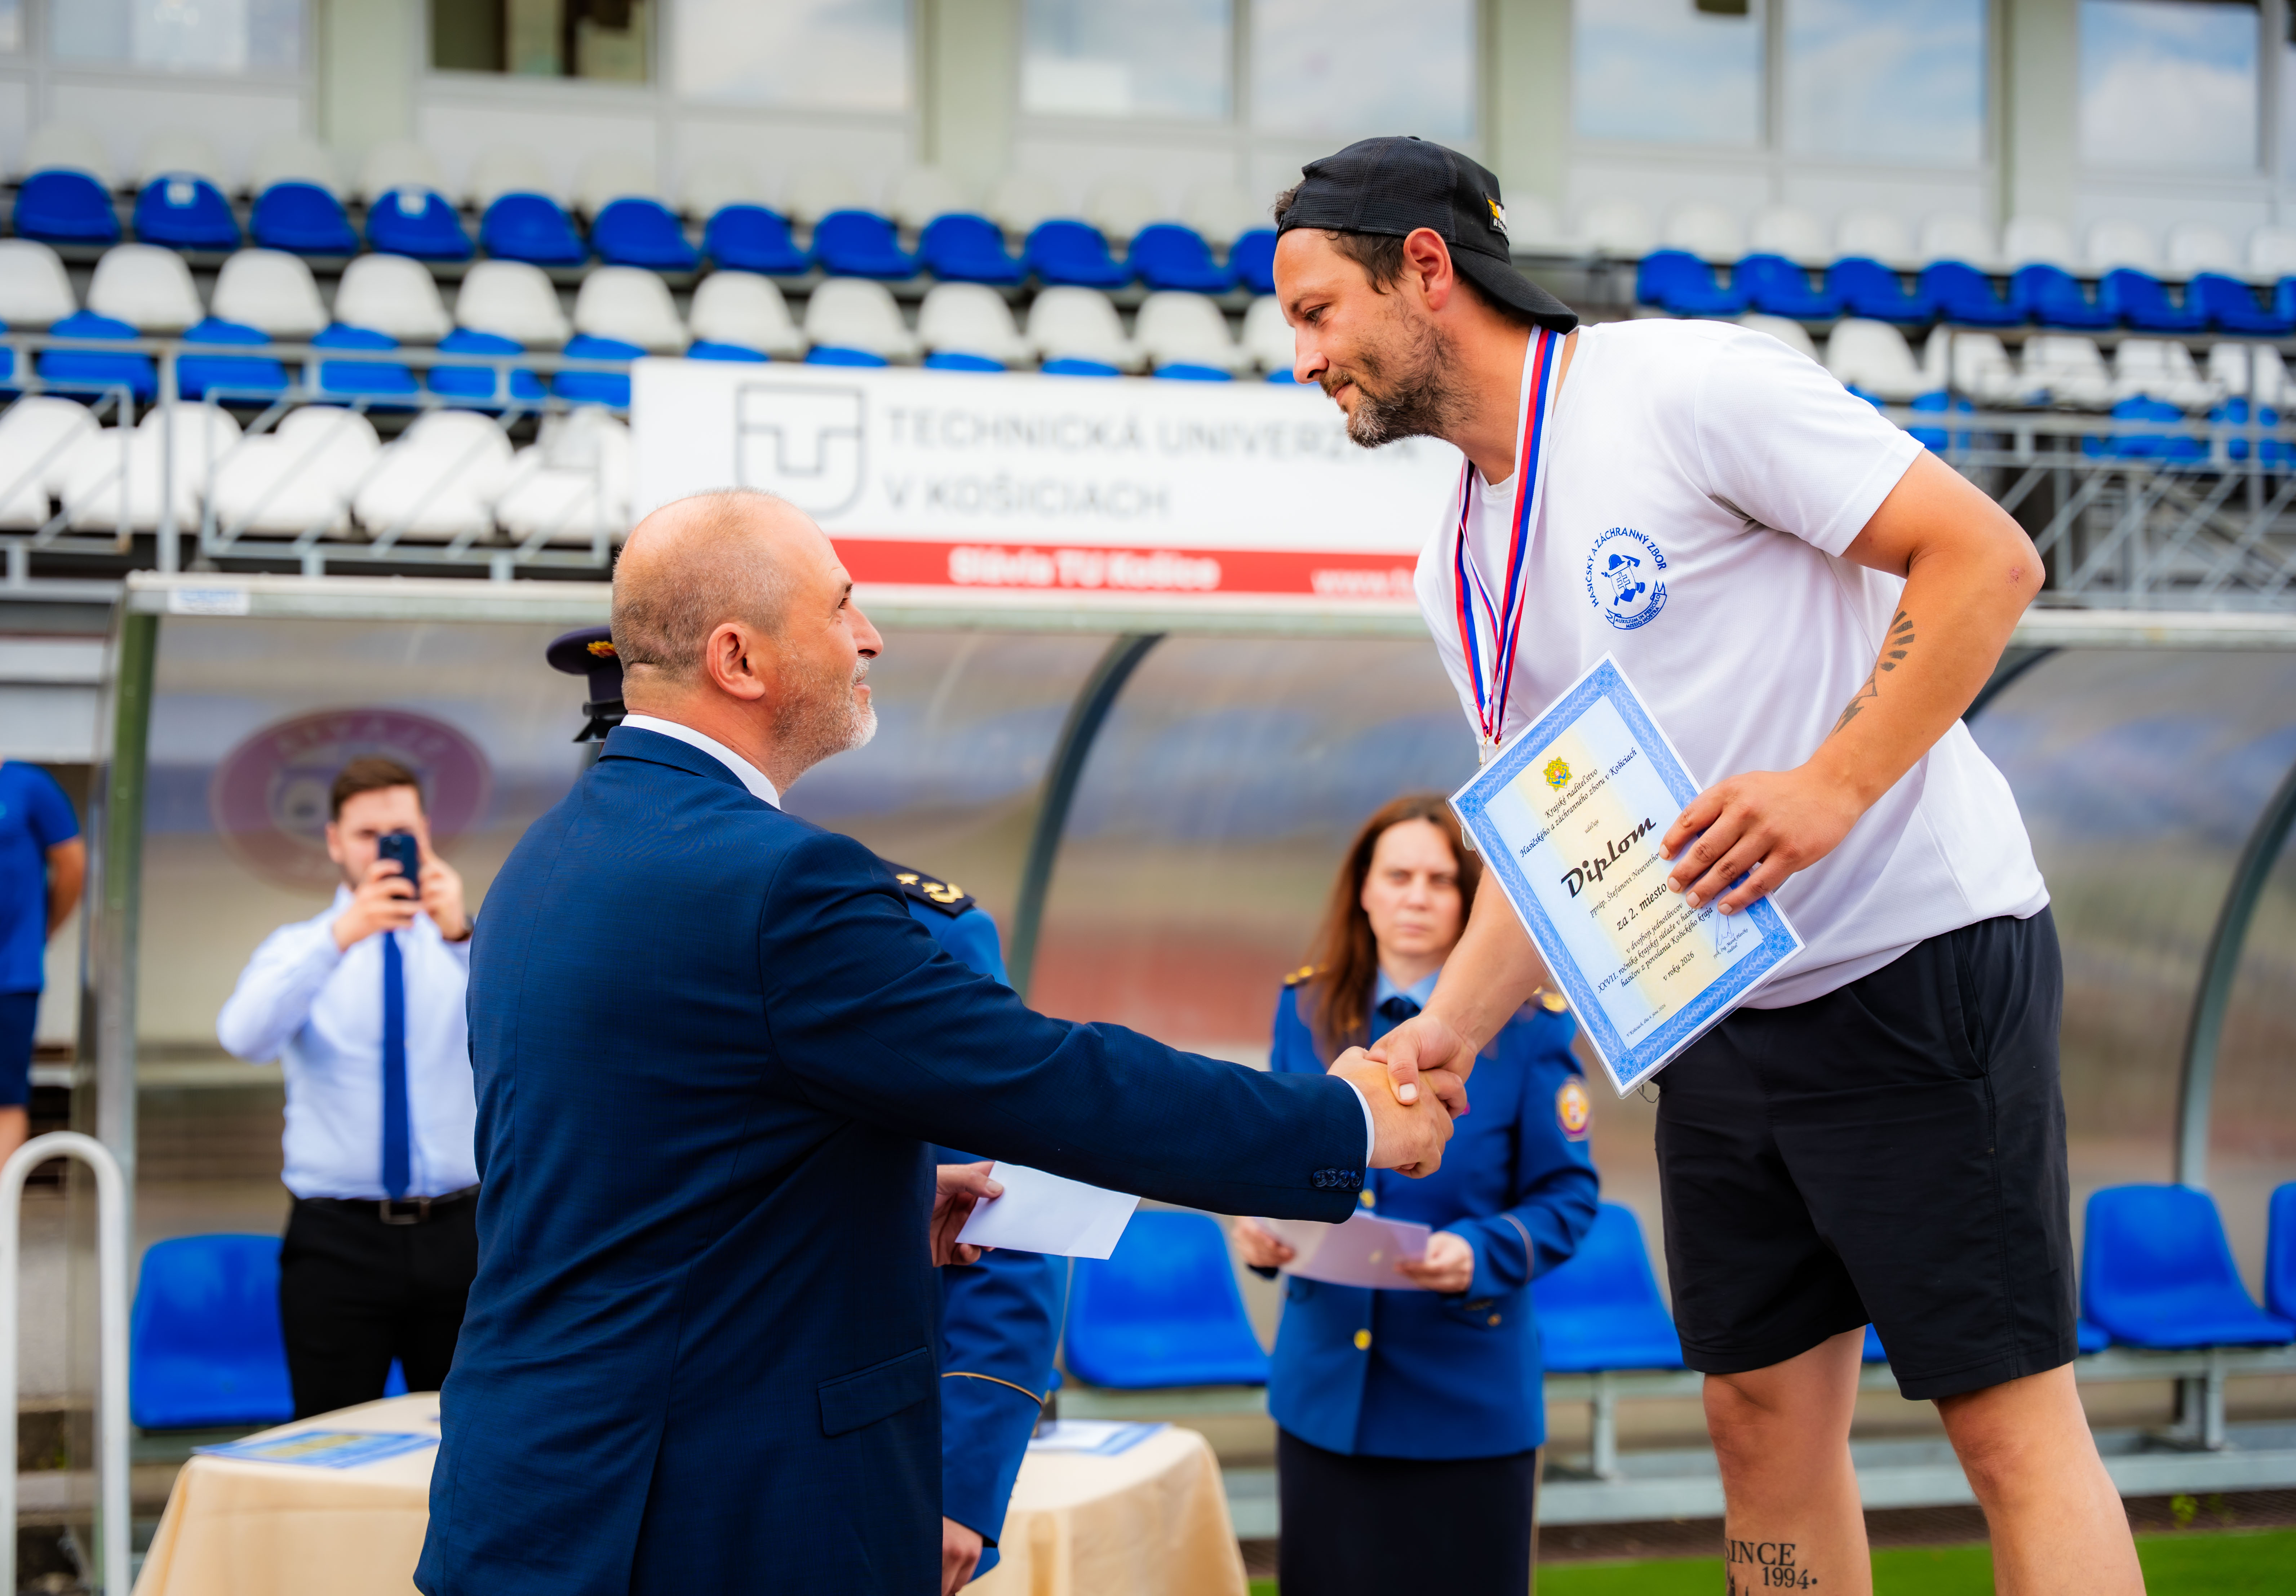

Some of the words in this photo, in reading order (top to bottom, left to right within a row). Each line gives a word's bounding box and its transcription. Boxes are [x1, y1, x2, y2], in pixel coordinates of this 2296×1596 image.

[886, 406, 1143, 453] TECHNICKÁ
[1158, 418, 1418, 463] UNIVERZA
[885, 474, 912, 511] V
[927, 471, 1169, 519] KOŠICIACH
[1591, 548, 1597, 556] A
[1595, 527, 1649, 548] ZÁCHRANNÝ
[1646, 542, 1667, 570] ZBOR
[1055, 548, 1105, 587] TU
[1107, 550, 1222, 591] Košice
[1585, 555, 1599, 608] HASIČSKÝ
[1643, 595, 1661, 616] PERICULO
[1643, 607, 1660, 623] NOSTRA
[1520, 828, 1550, 858] Hasičského
[1555, 793, 1588, 826] záchranného
[1589, 778, 1605, 795] zboru
[1609, 747, 1637, 776] Košiciach
[1544, 795, 1566, 818] Krajské
[1566, 769, 1597, 799] riaditeľstvo
[1560, 817, 1656, 898] Diplom
[1590, 900, 1606, 918] ppráp.
[1606, 875, 1632, 902] Štefanovi
[1617, 916, 1628, 931] za
[1628, 908, 1638, 920] 2.
[1639, 883, 1667, 911] miesto
[1621, 968, 1640, 987] hasičov
[1645, 942, 1671, 969] povolania
[1670, 919, 1698, 944] Košického
[1697, 907, 1713, 922] kraja
[1631, 928, 1652, 950] dvojboji
[1651, 902, 1683, 935] jednotlivcov
[1597, 972, 1618, 993] XXVII.
[1618, 956, 1638, 975] ročníka
[1637, 936, 1659, 958] krajskej
[1658, 924, 1676, 941] súťaže
[1667, 964, 1681, 977] roku
[1680, 951, 1694, 966] 2026
